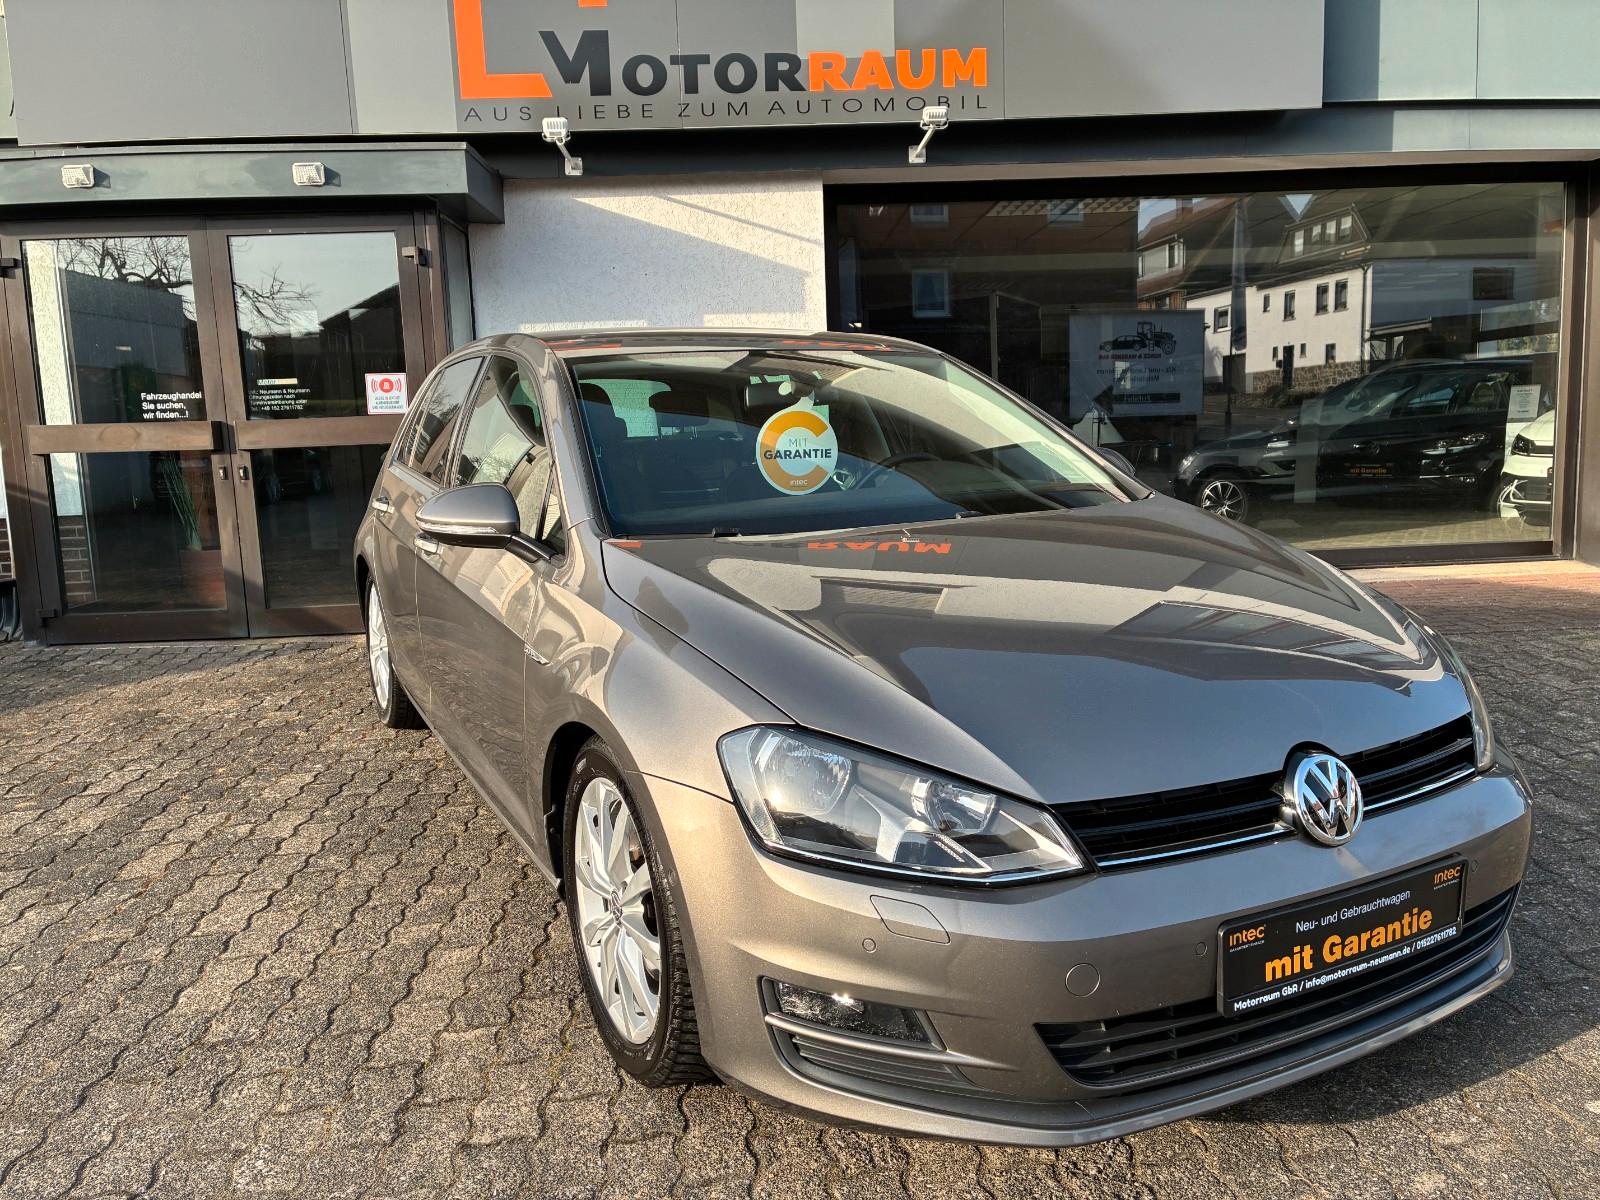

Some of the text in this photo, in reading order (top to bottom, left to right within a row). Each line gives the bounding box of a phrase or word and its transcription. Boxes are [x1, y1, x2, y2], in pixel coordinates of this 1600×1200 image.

[464, 106, 532, 122] AUS
[678, 101, 749, 118] ZUM
[768, 94, 988, 115] AUTOMOBIL
[140, 391, 203, 401] Fahrzeughandel
[142, 402, 186, 410] Sie suchen,
[788, 438, 808, 448] MIT
[763, 448, 832, 460] GARANTIE
[1295, 889, 1411, 934] Neu- und Gebrauchtwagen
[1265, 906, 1433, 983] mit Garantie
[1234, 990, 1281, 1012] Motorraum
[1281, 983, 1298, 997] GbR
[1305, 945, 1411, 989] info@motorraum-neumann.de
